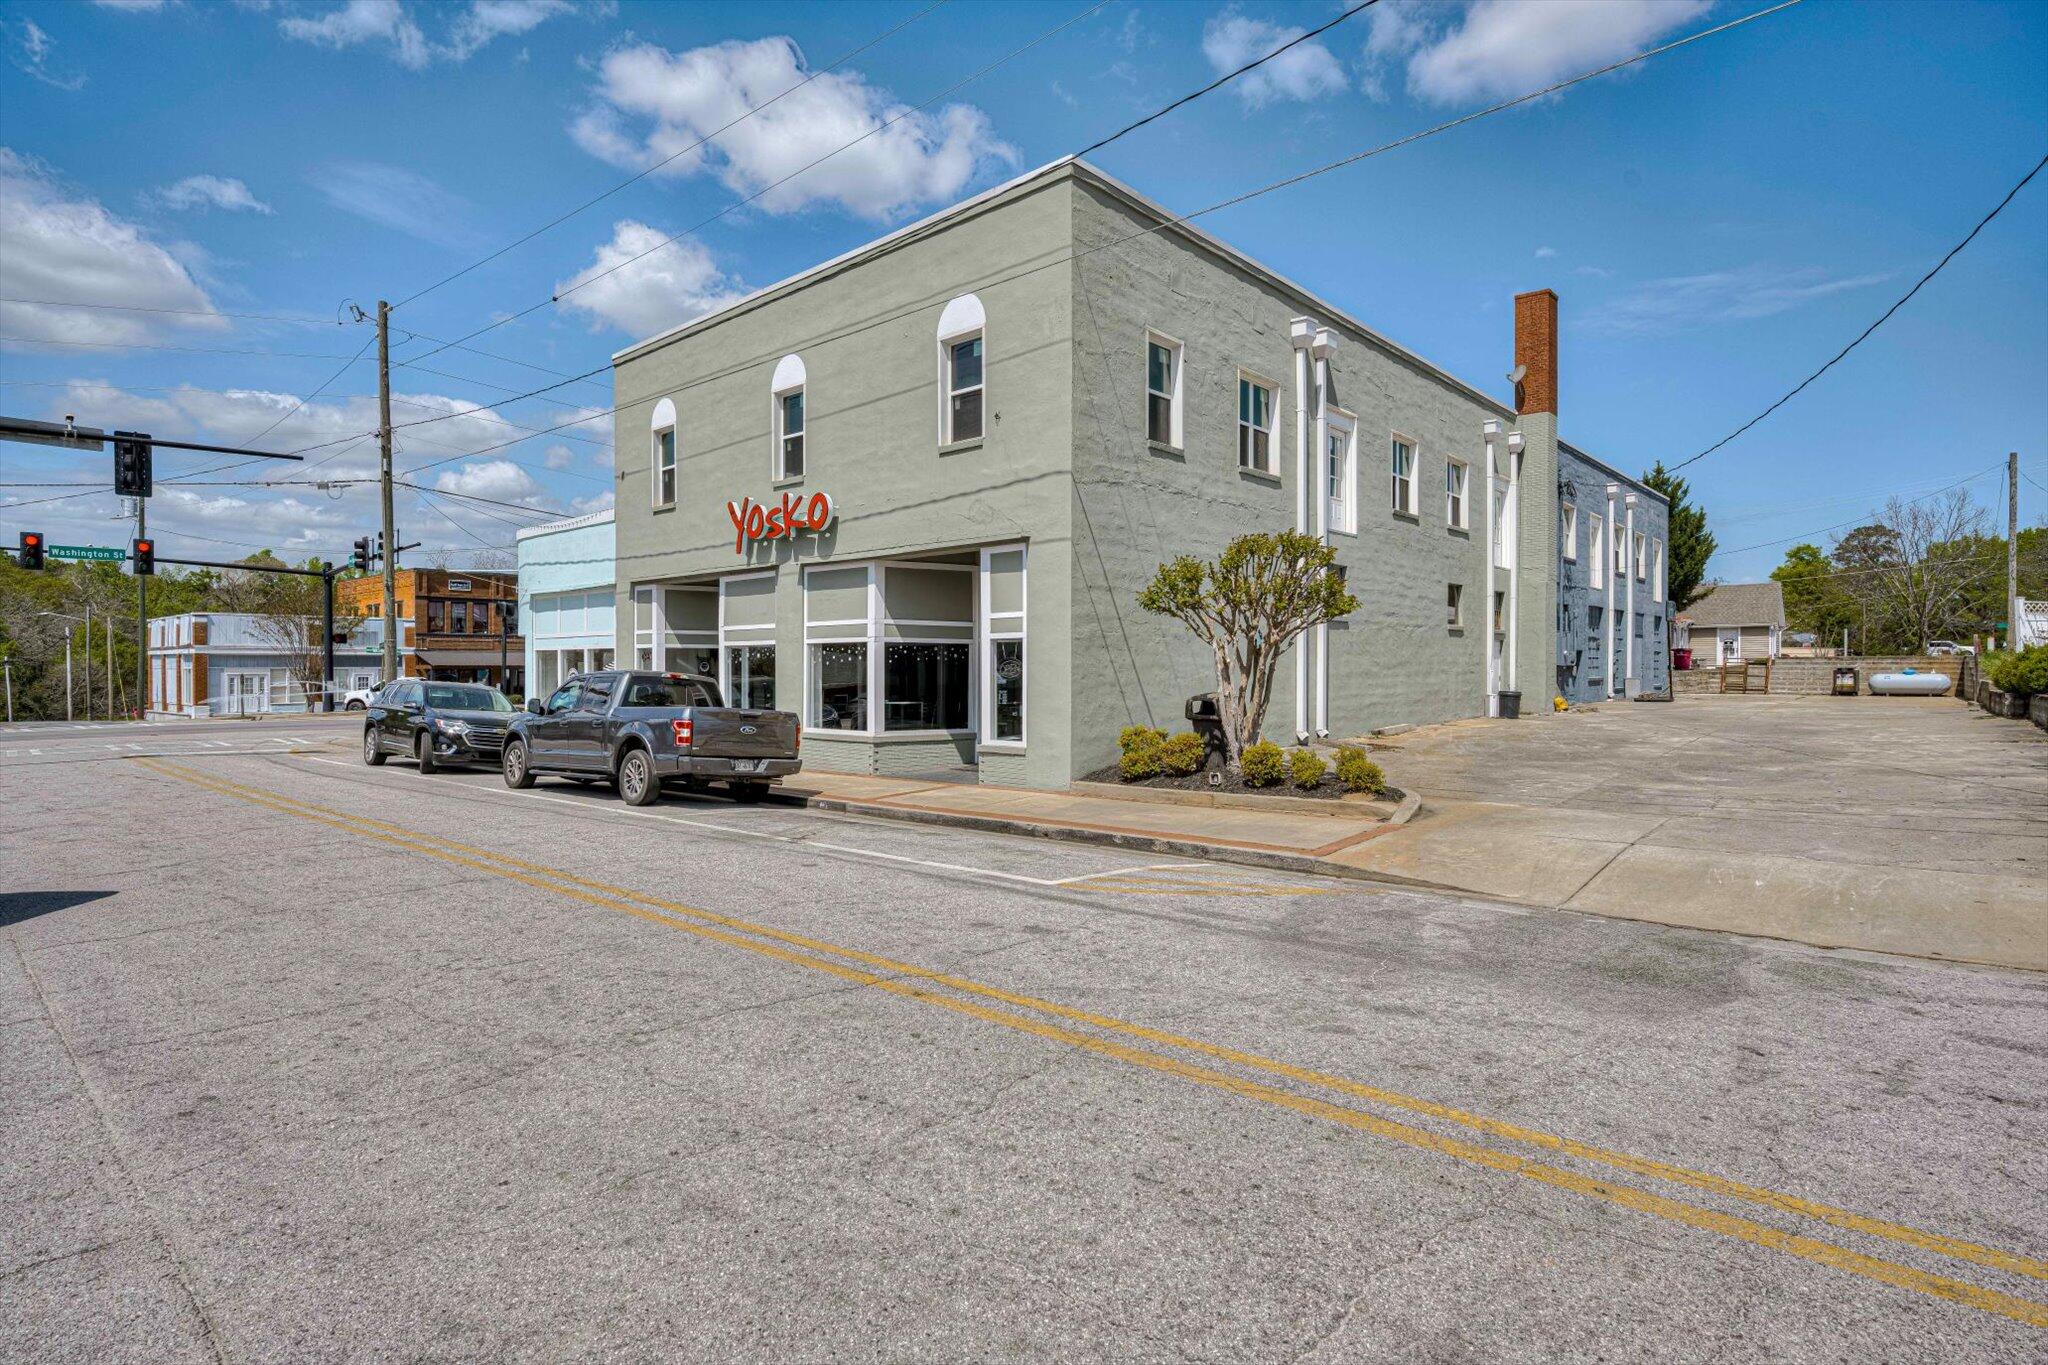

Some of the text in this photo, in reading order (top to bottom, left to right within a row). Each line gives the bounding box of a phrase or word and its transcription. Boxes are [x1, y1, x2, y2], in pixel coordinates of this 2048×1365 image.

[727, 491, 833, 555] YOSKO
[51, 548, 124, 559] Washington St
